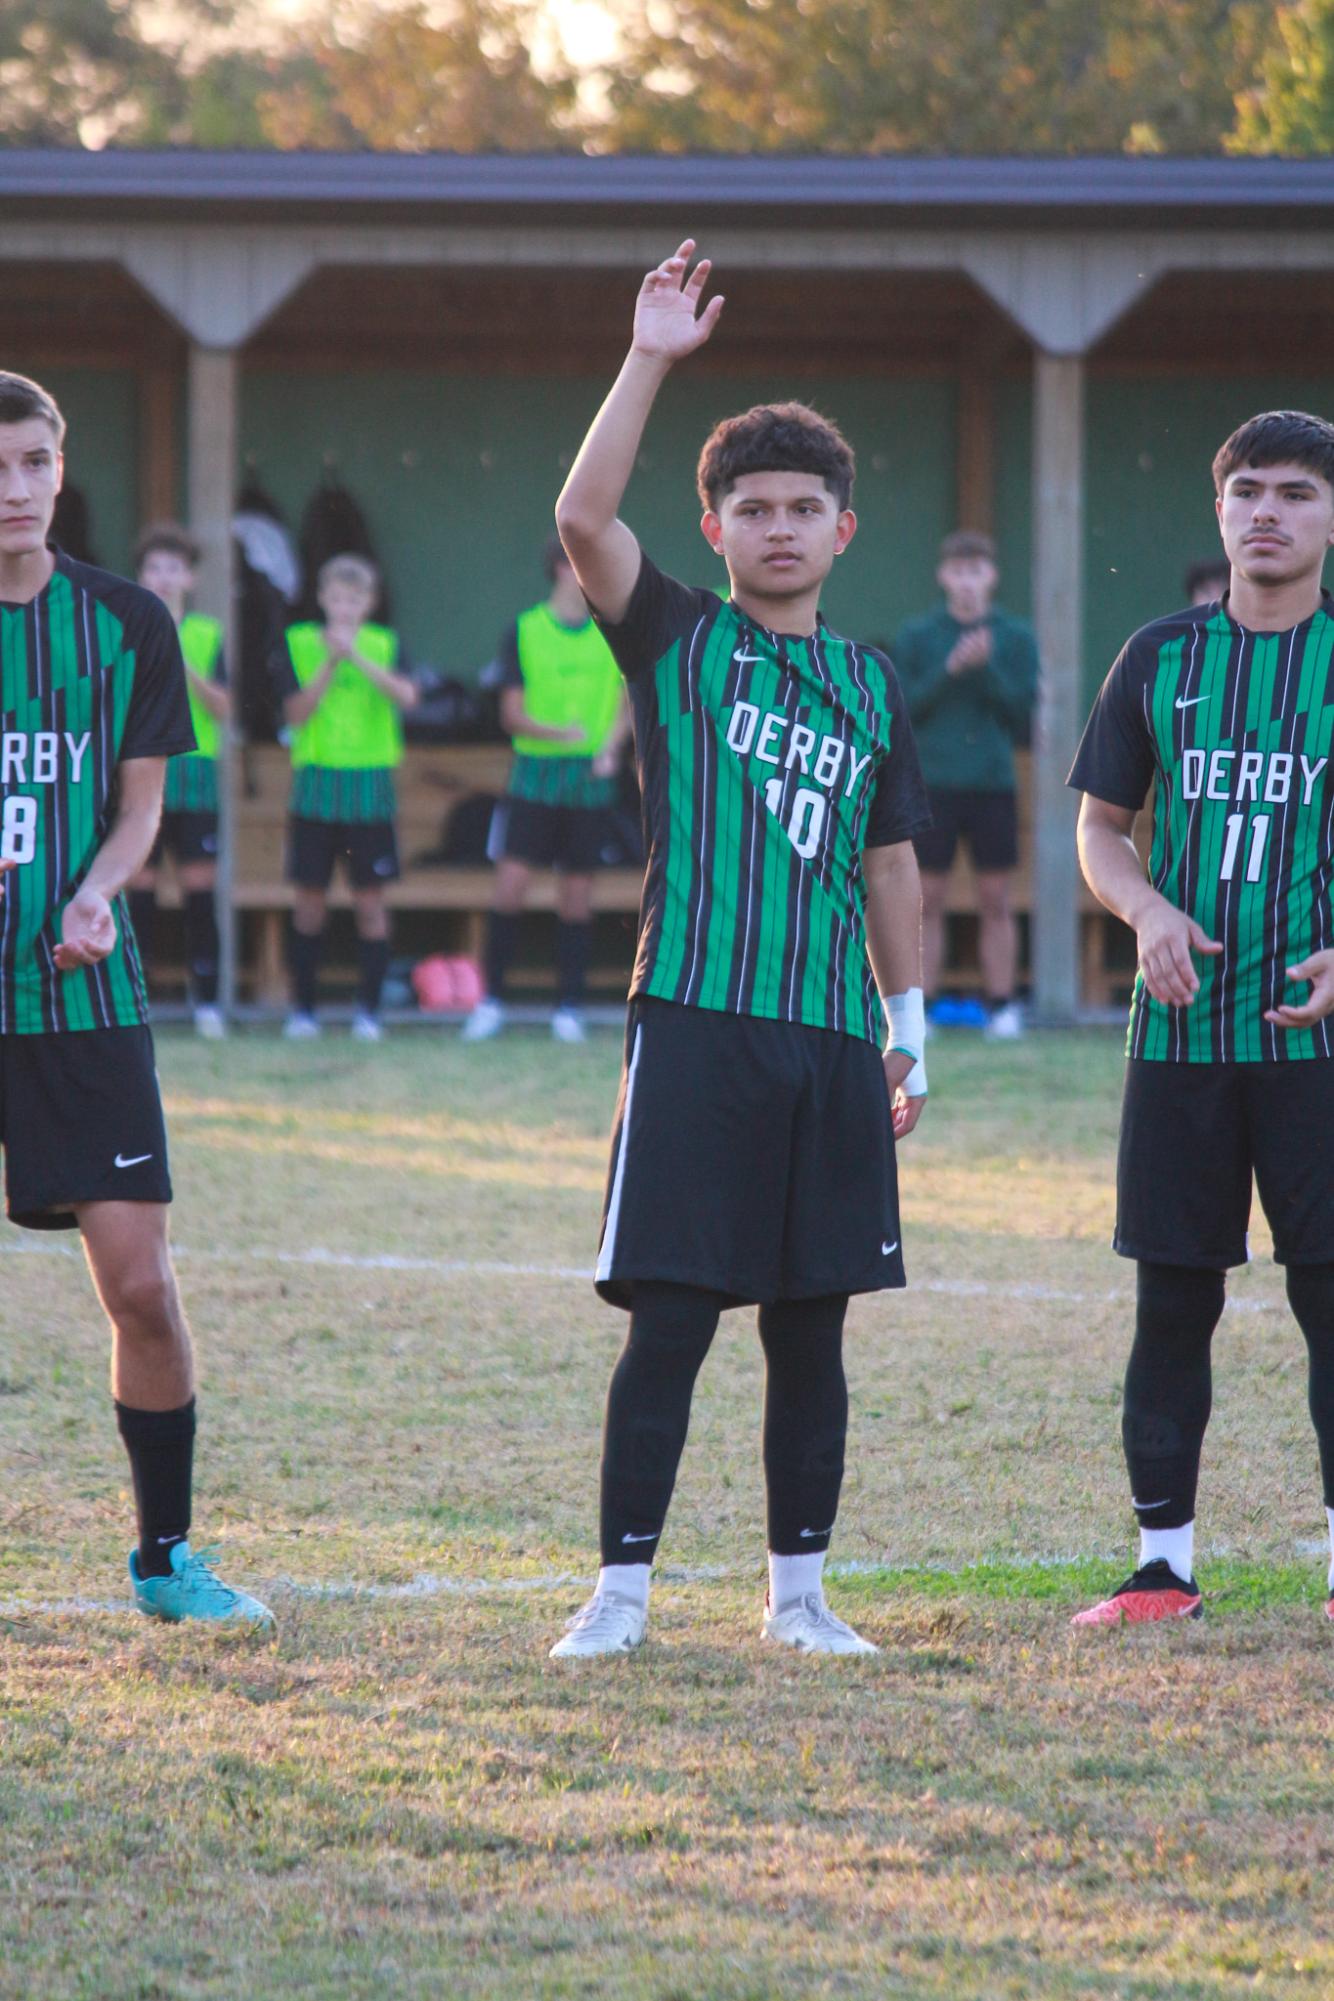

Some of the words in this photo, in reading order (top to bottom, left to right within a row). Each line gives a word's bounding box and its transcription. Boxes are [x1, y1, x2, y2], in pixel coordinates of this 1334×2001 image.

[1, 732, 91, 783] RBY
[727, 701, 871, 797] DERBY
[1183, 749, 1328, 805] DERBY
[1, 796, 37, 864] 8
[1220, 814, 1270, 882] 11
